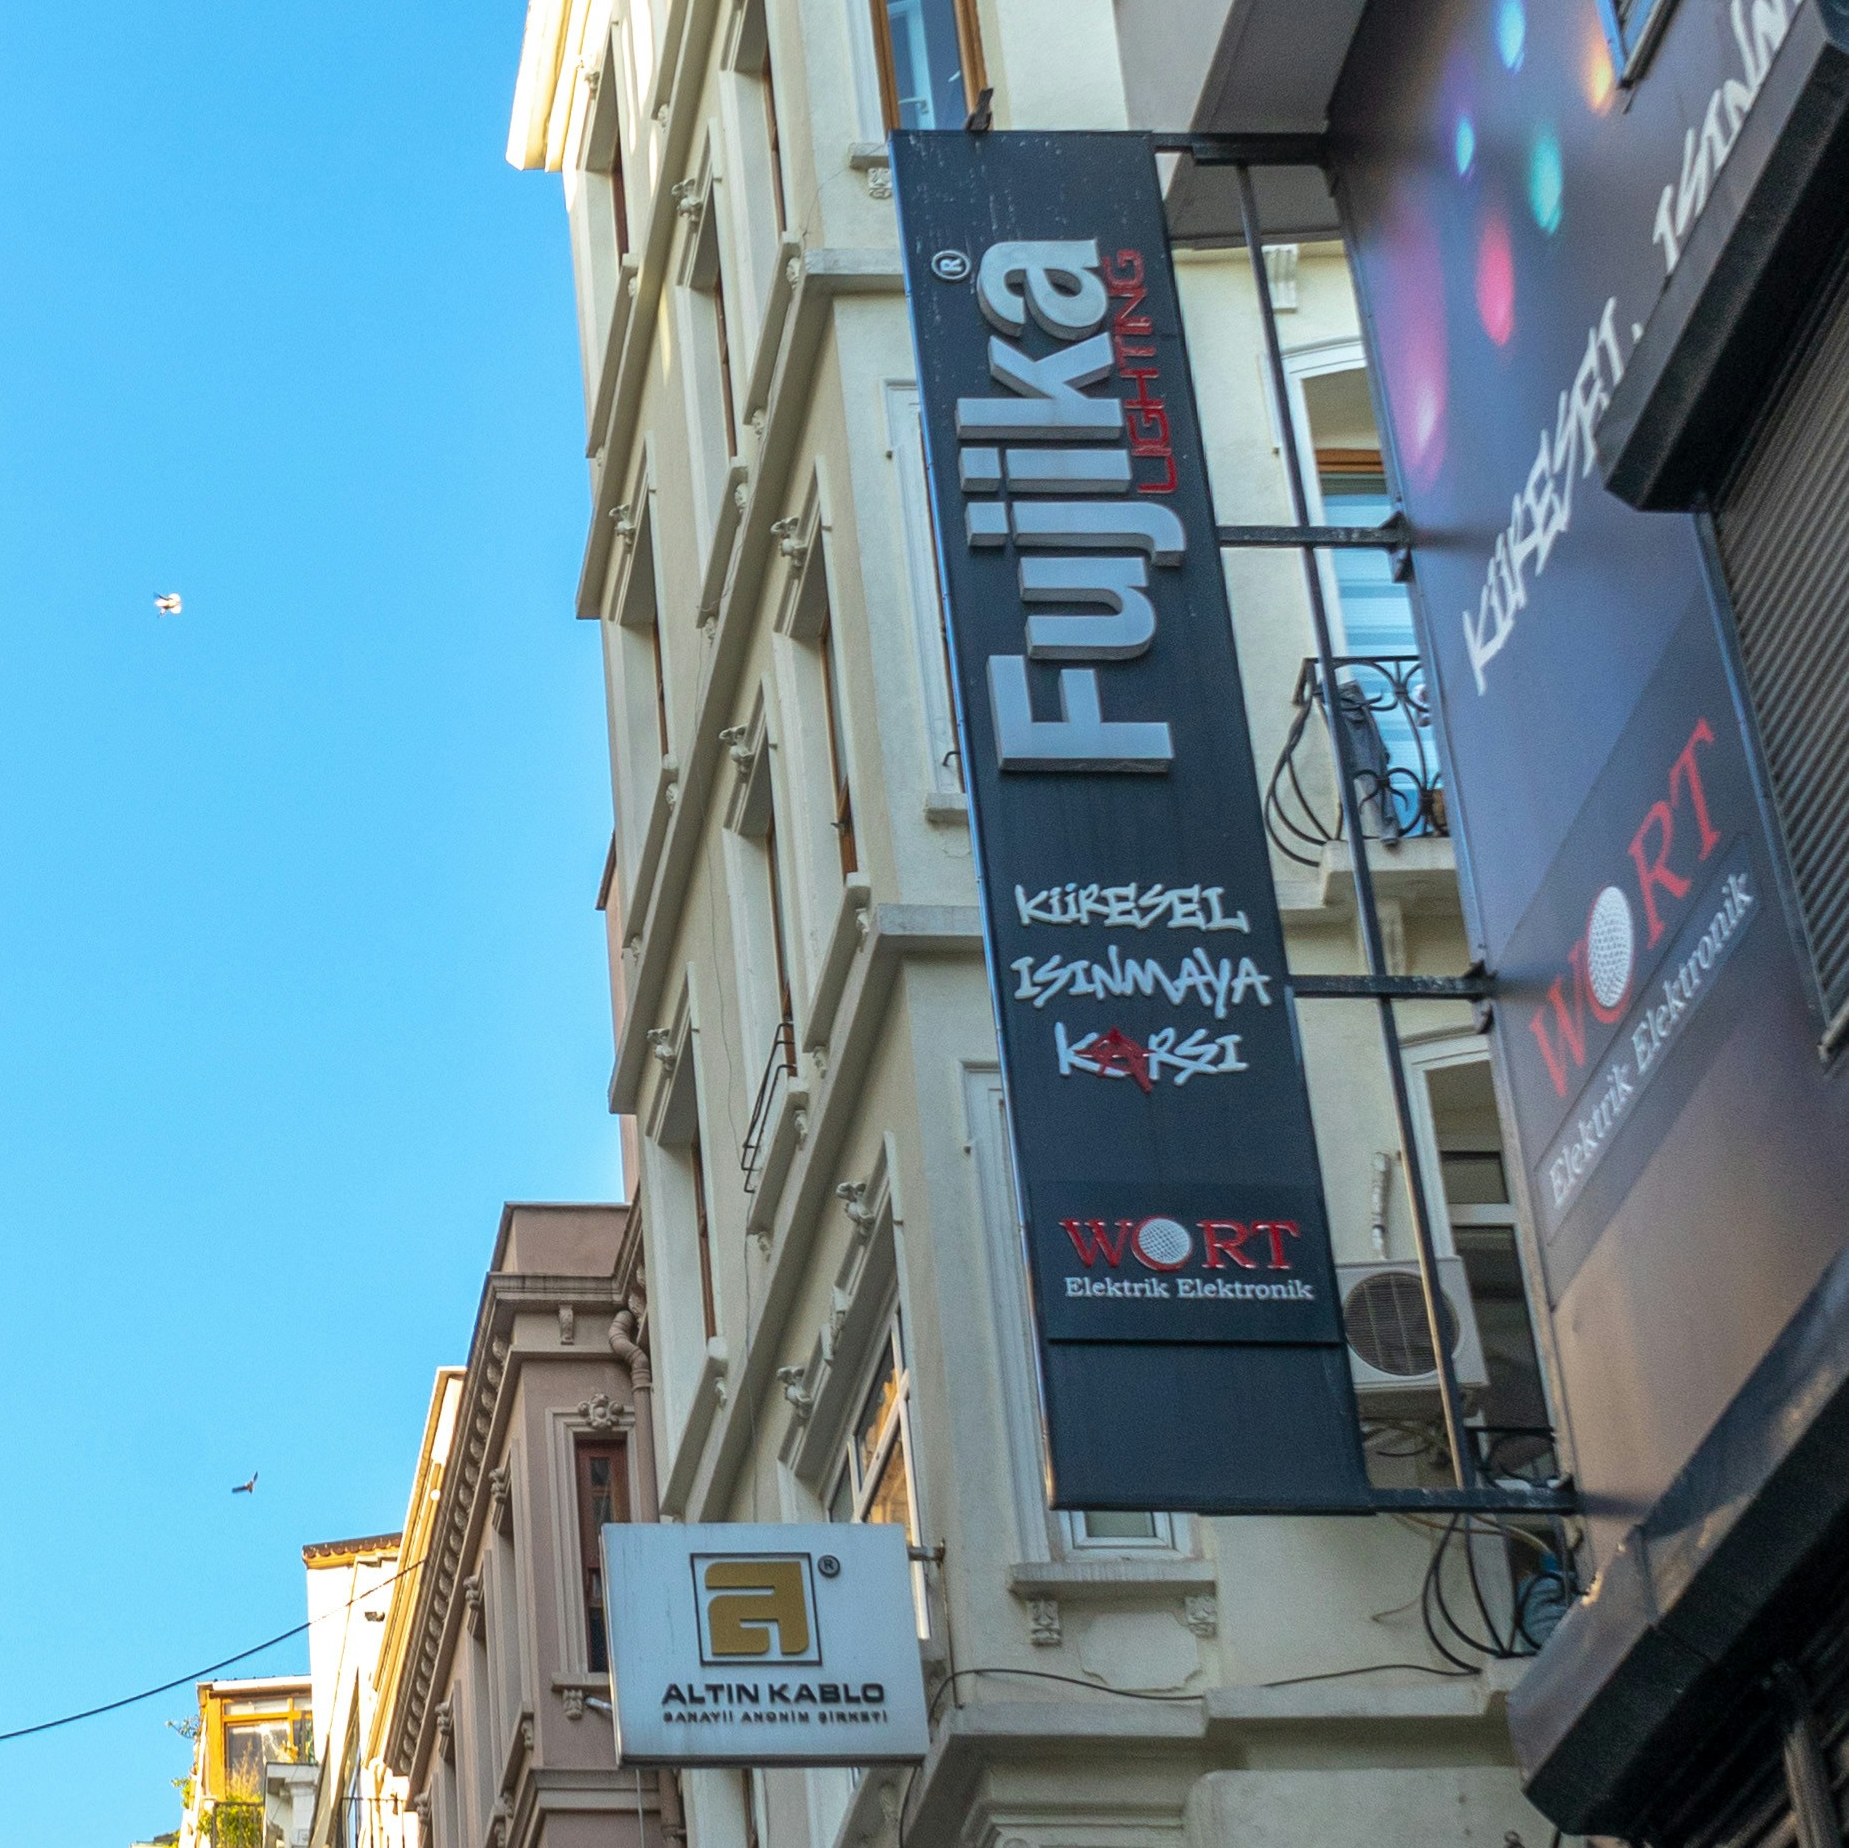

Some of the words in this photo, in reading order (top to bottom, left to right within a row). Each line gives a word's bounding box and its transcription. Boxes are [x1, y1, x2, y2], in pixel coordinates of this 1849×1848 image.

[1100, 249, 1178, 495] LIGHTING
[954, 237, 1188, 773] Fujika
[1014, 881, 1250, 934] KÜRESEL
[1527, 715, 1723, 1101] WORT
[1009, 944, 1273, 1020] ISINMAYA
[1549, 1063, 1635, 1209] Elektrik
[1629, 869, 1753, 1079] Elektronik
[1058, 1215, 1302, 1272] WORT
[1065, 1276, 1169, 1299] Elektrik
[1176, 1277, 1315, 1300] Elektronik
[662, 1683, 760, 1705] ALTIN
[767, 1683, 887, 1704] KABLO
